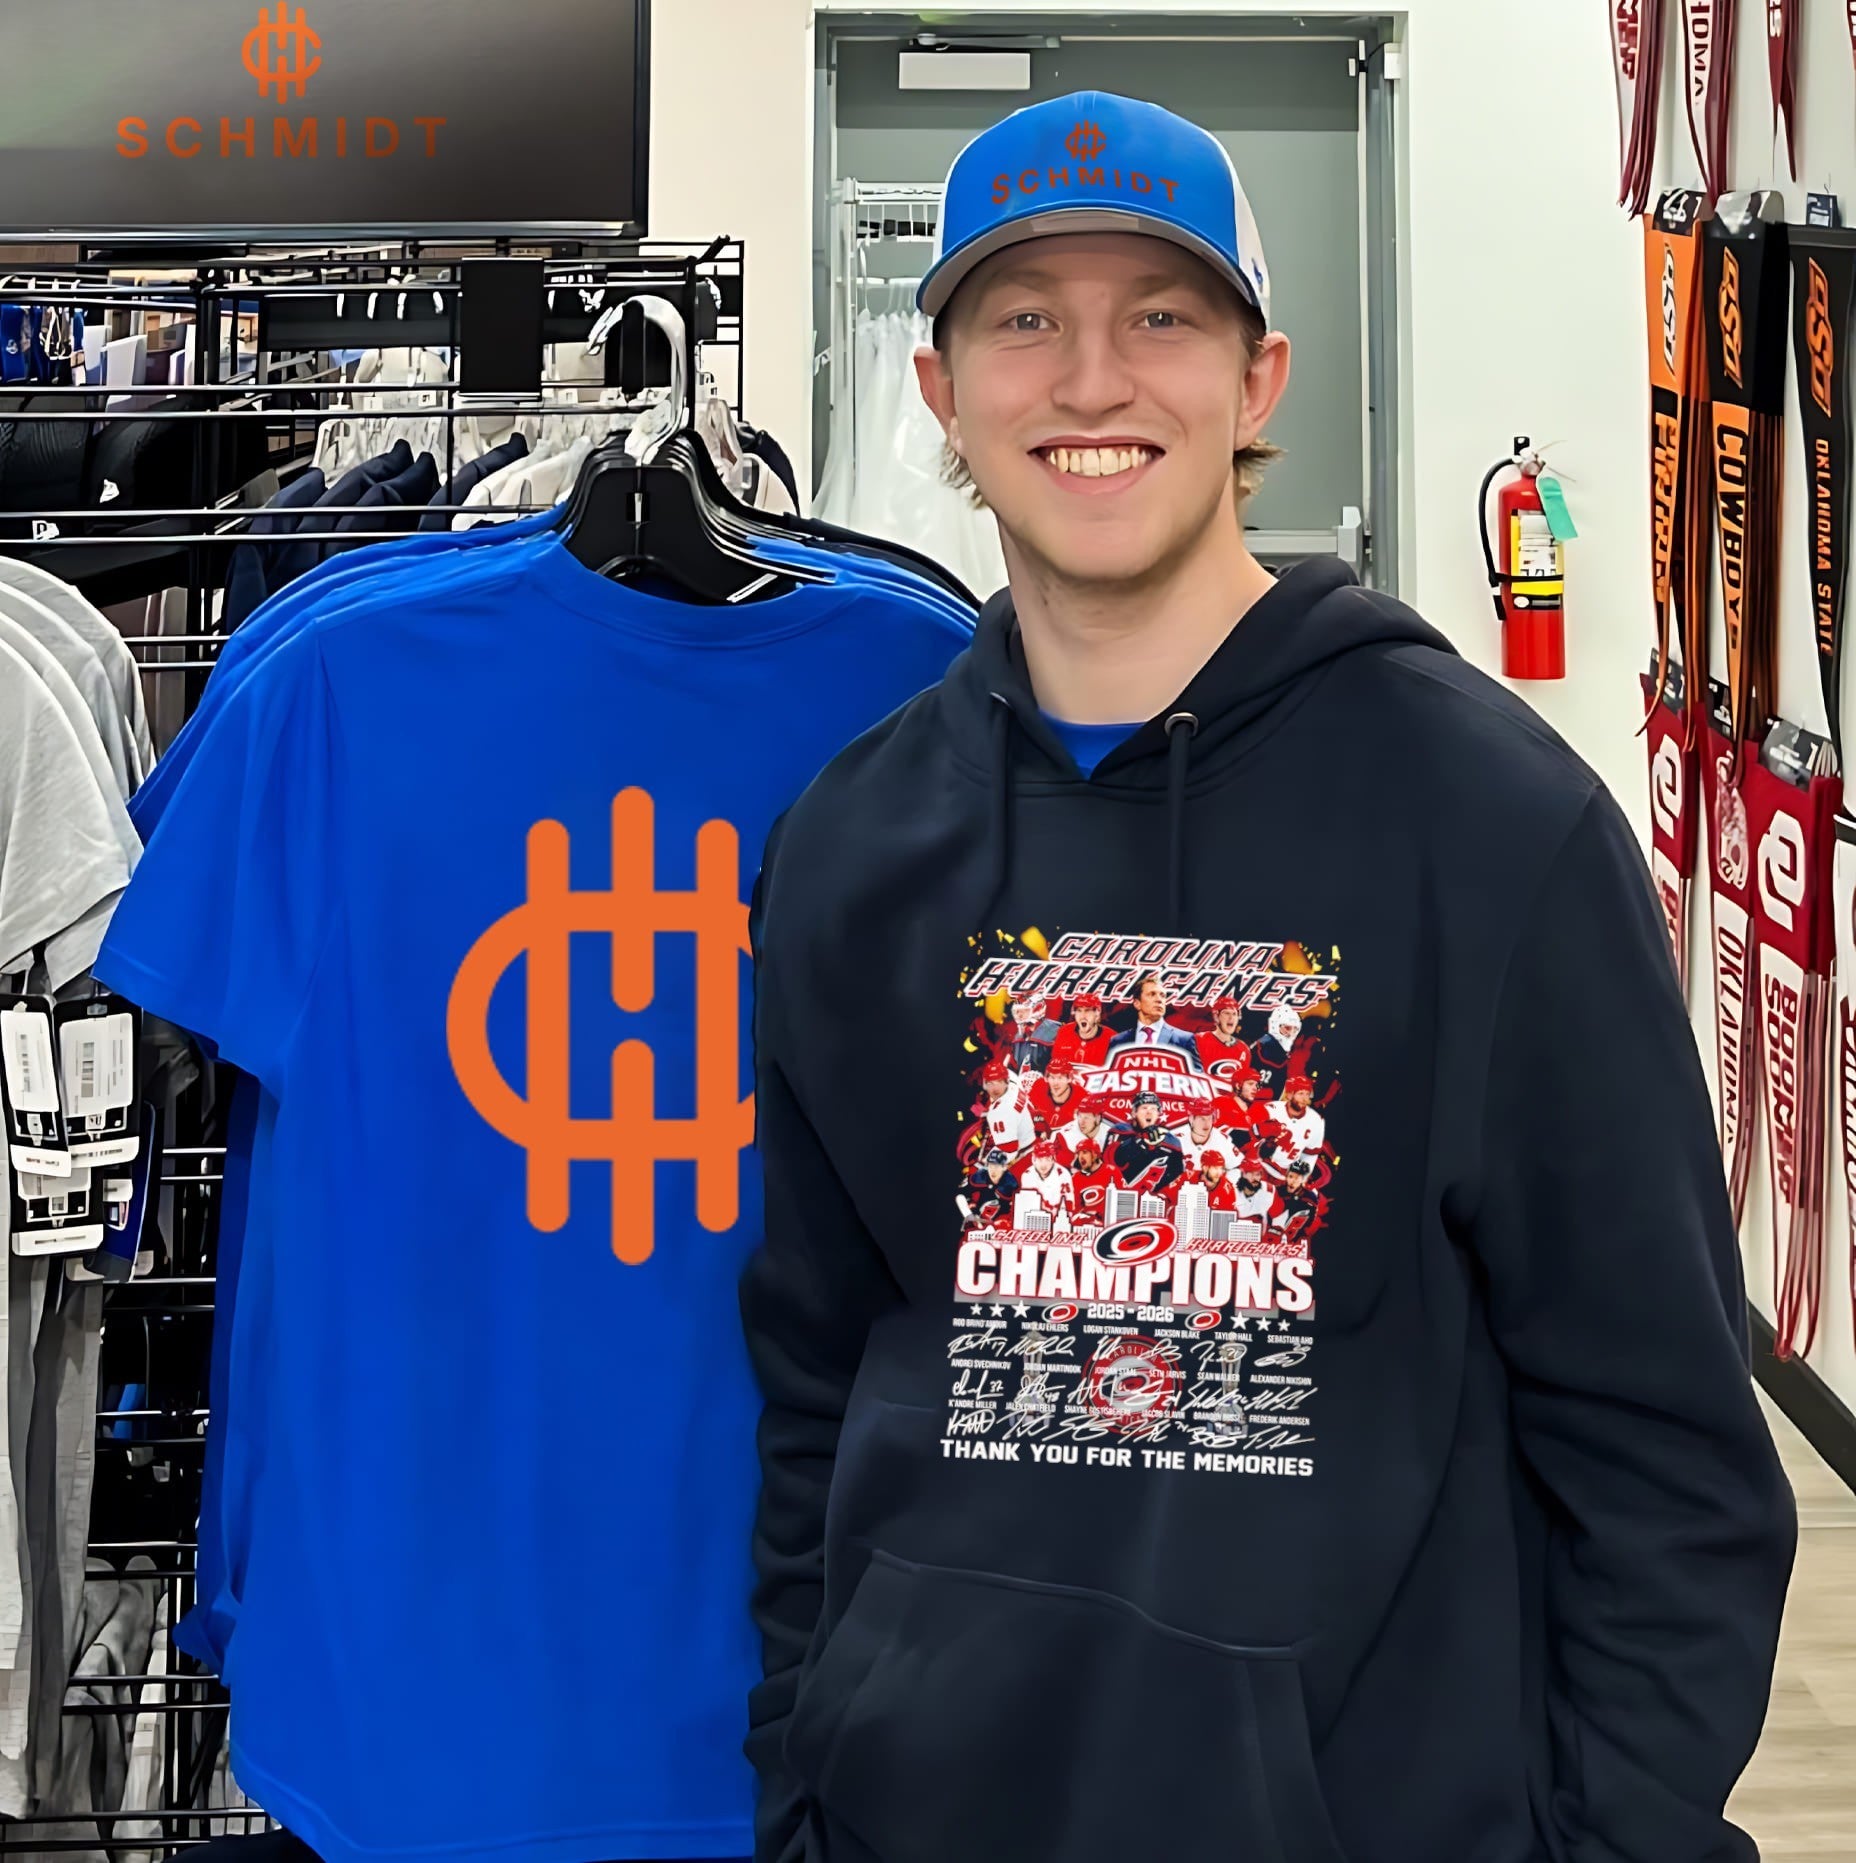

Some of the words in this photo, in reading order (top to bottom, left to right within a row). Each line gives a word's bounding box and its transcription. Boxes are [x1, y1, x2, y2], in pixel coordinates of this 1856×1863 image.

[115, 116, 447, 159] SCHMIDT
[991, 166, 1180, 205] SCHMIDT
[1049, 931, 1285, 972] CAROLINA
[963, 957, 1337, 1013] HURRICANES
[1718, 925, 1745, 1144] OKLAHOMA
[1123, 1056, 1176, 1071] NHL
[1085, 1069, 1213, 1102] EASTERN
[1109, 1098, 1186, 1112] CONNCE
[991, 1229, 1086, 1244] CAROLINA
[1185, 1238, 1306, 1257] HURRICANES
[956, 1241, 1314, 1312] CHAMPIONS
[1087, 1303, 1125, 1320] 2025
[1136, 1305, 1175, 1323] 2026
[940, 1438, 1021, 1462] THANK
[1030, 1443, 1079, 1465] YOU
[1086, 1445, 1133, 1468] FOR
[1141, 1449, 1186, 1471] THE
[1193, 1452, 1315, 1477] MEMORIES
